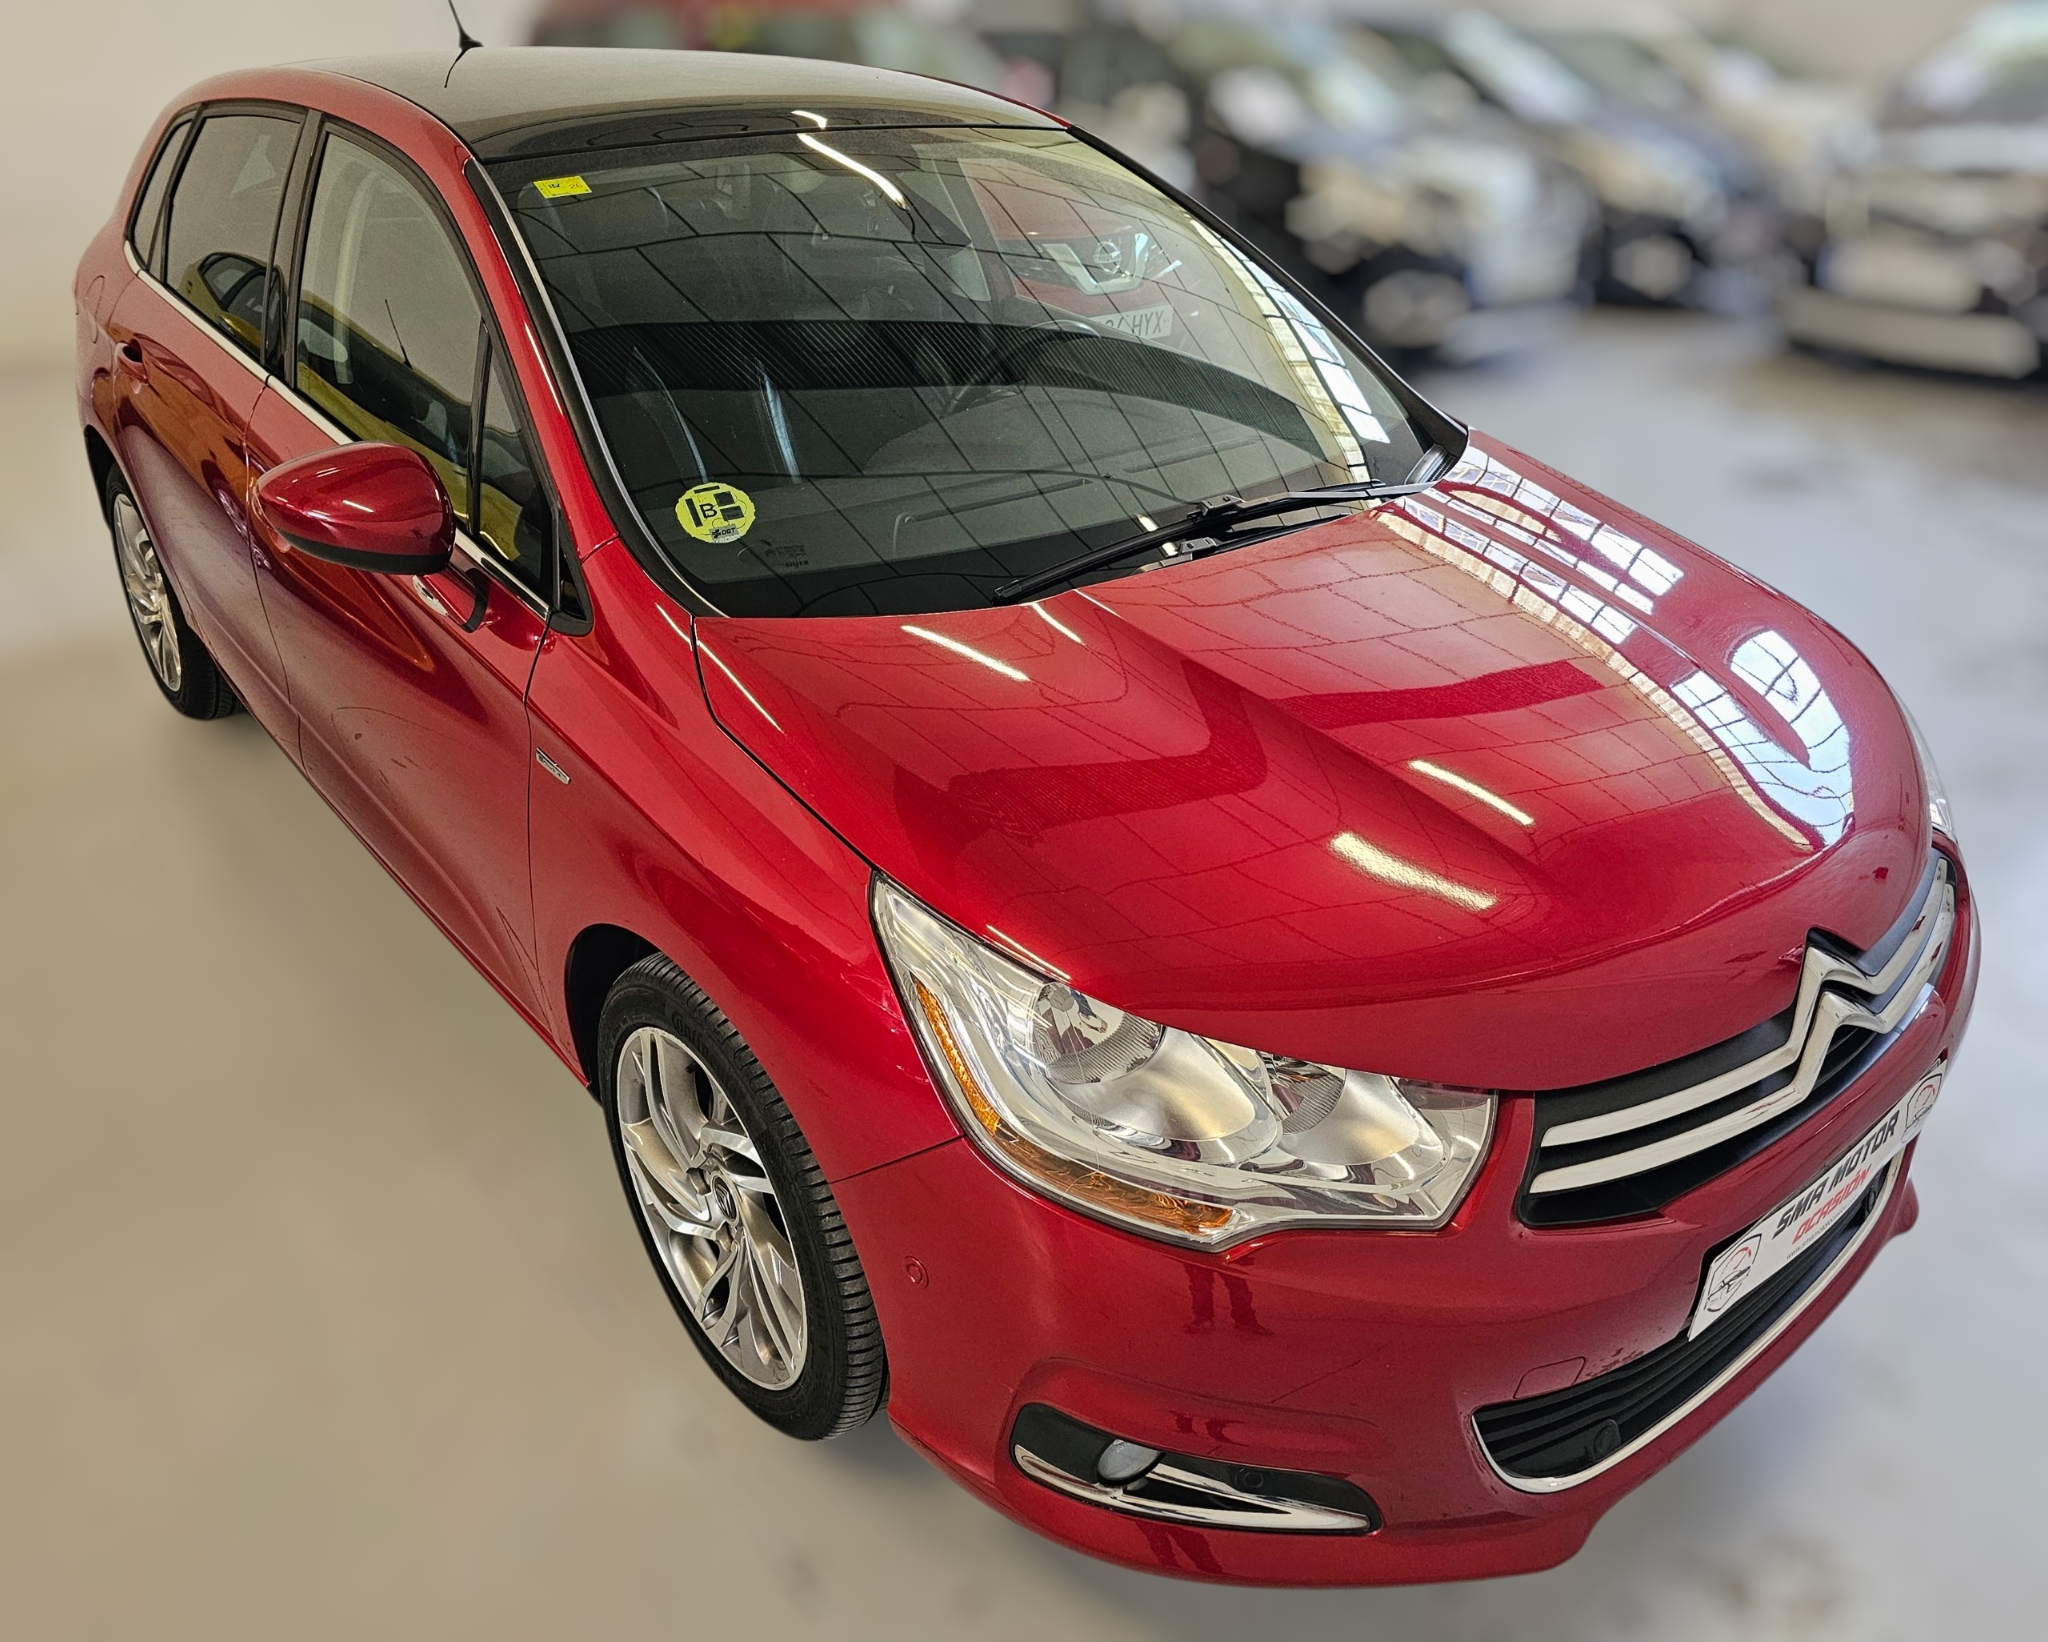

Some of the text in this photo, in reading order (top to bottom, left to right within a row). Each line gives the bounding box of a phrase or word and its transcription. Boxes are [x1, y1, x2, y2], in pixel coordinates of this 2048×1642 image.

[1133, 311, 1163, 335] HYX
[699, 503, 718, 518] B
[721, 527, 736, 535] DGT
[1772, 1177, 1829, 1240] SMA
[1828, 1110, 1899, 1193] MOTOR
[1792, 1165, 1872, 1244] OCASIÓN
